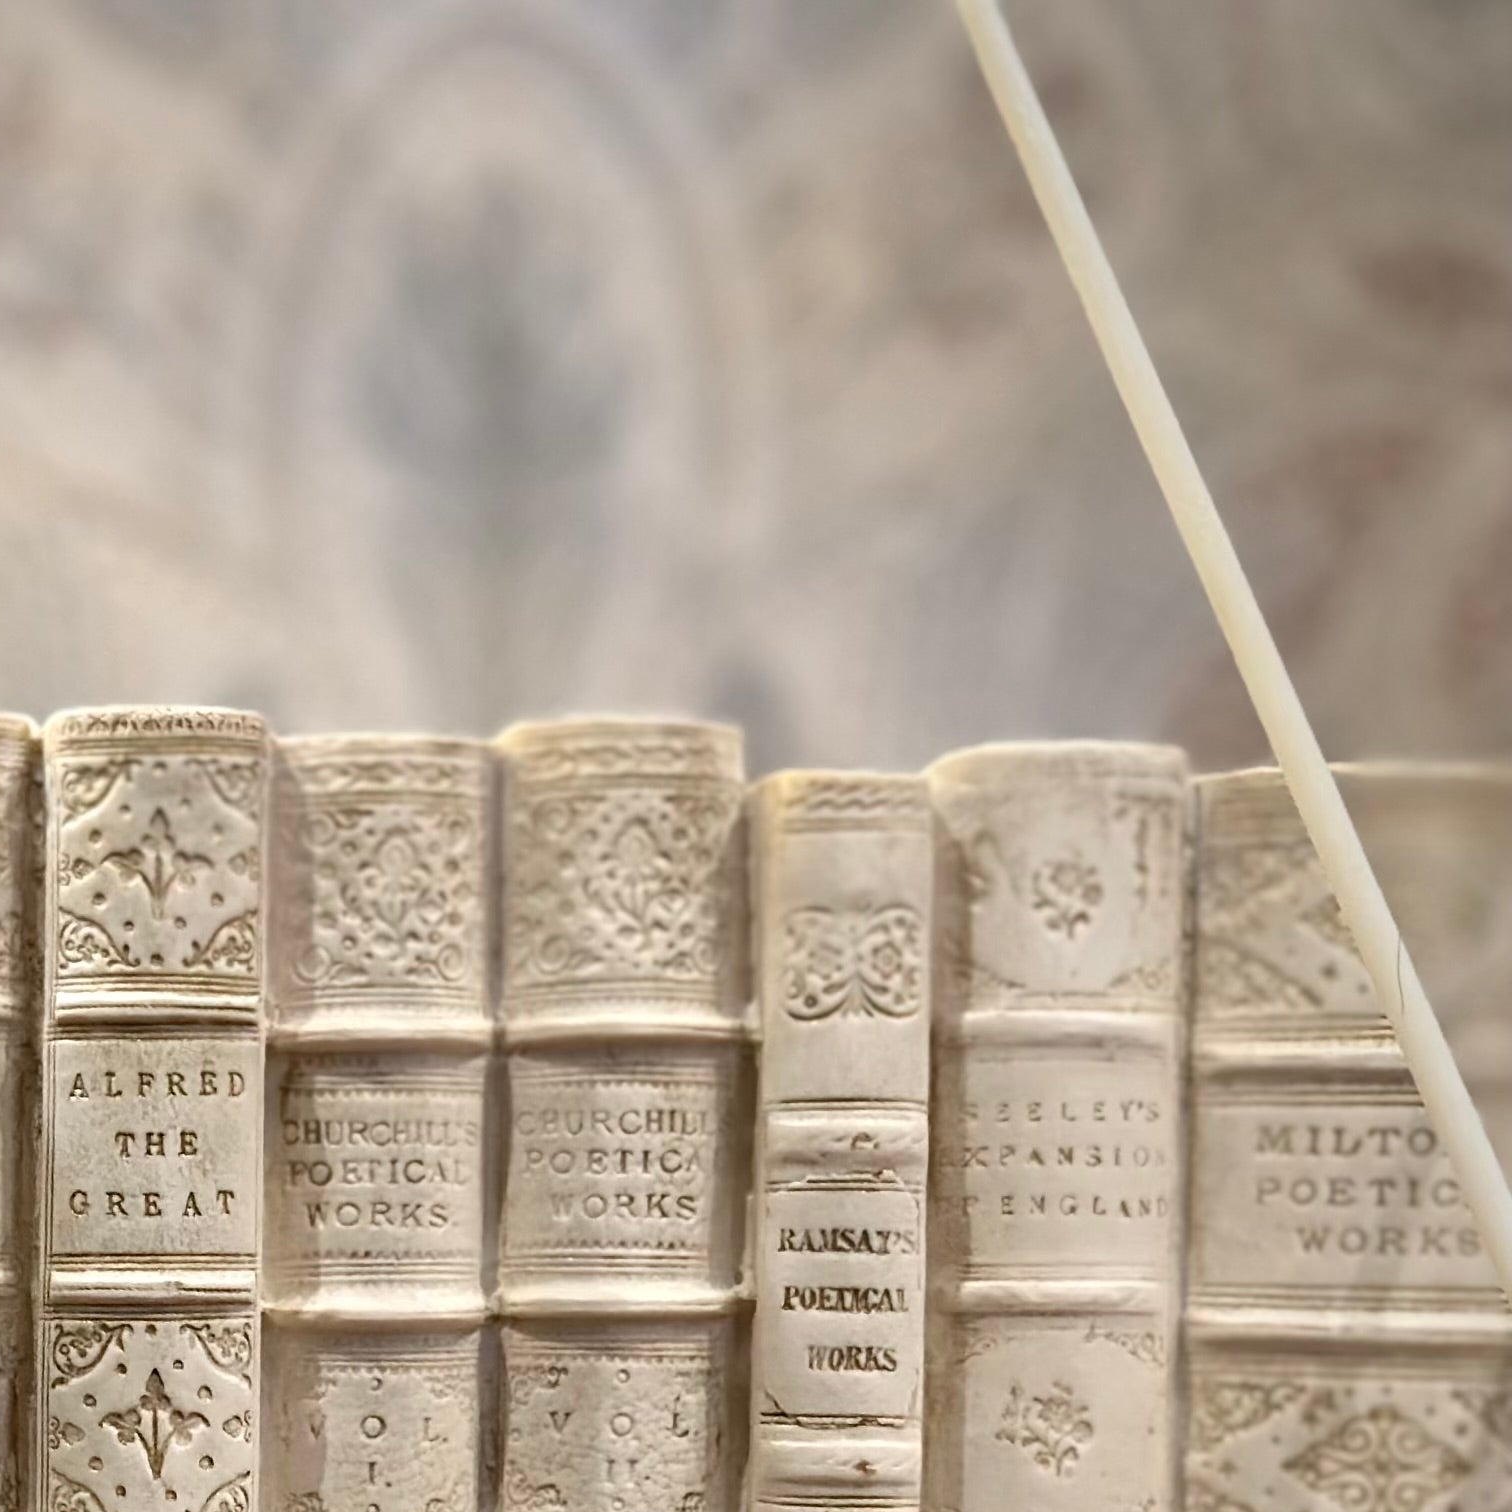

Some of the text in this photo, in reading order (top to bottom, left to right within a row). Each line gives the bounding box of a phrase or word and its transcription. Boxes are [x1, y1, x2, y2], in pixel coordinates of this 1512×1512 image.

[69, 1071, 246, 1098] ALFRED
[115, 1132, 200, 1158] THE
[1255, 1125, 1448, 1156] MILTO
[288, 1158, 473, 1186] POETICAL
[69, 1189, 237, 1218] GREAT
[1255, 1177, 1471, 1208] POETIC
[1000, 1196, 1169, 1218] ENGLAND
[778, 1228, 915, 1254] RAMSAY'S
[1297, 1226, 1482, 1256] WORKS
[782, 1286, 908, 1313] POETICAL
[808, 1345, 897, 1371] WORKS
